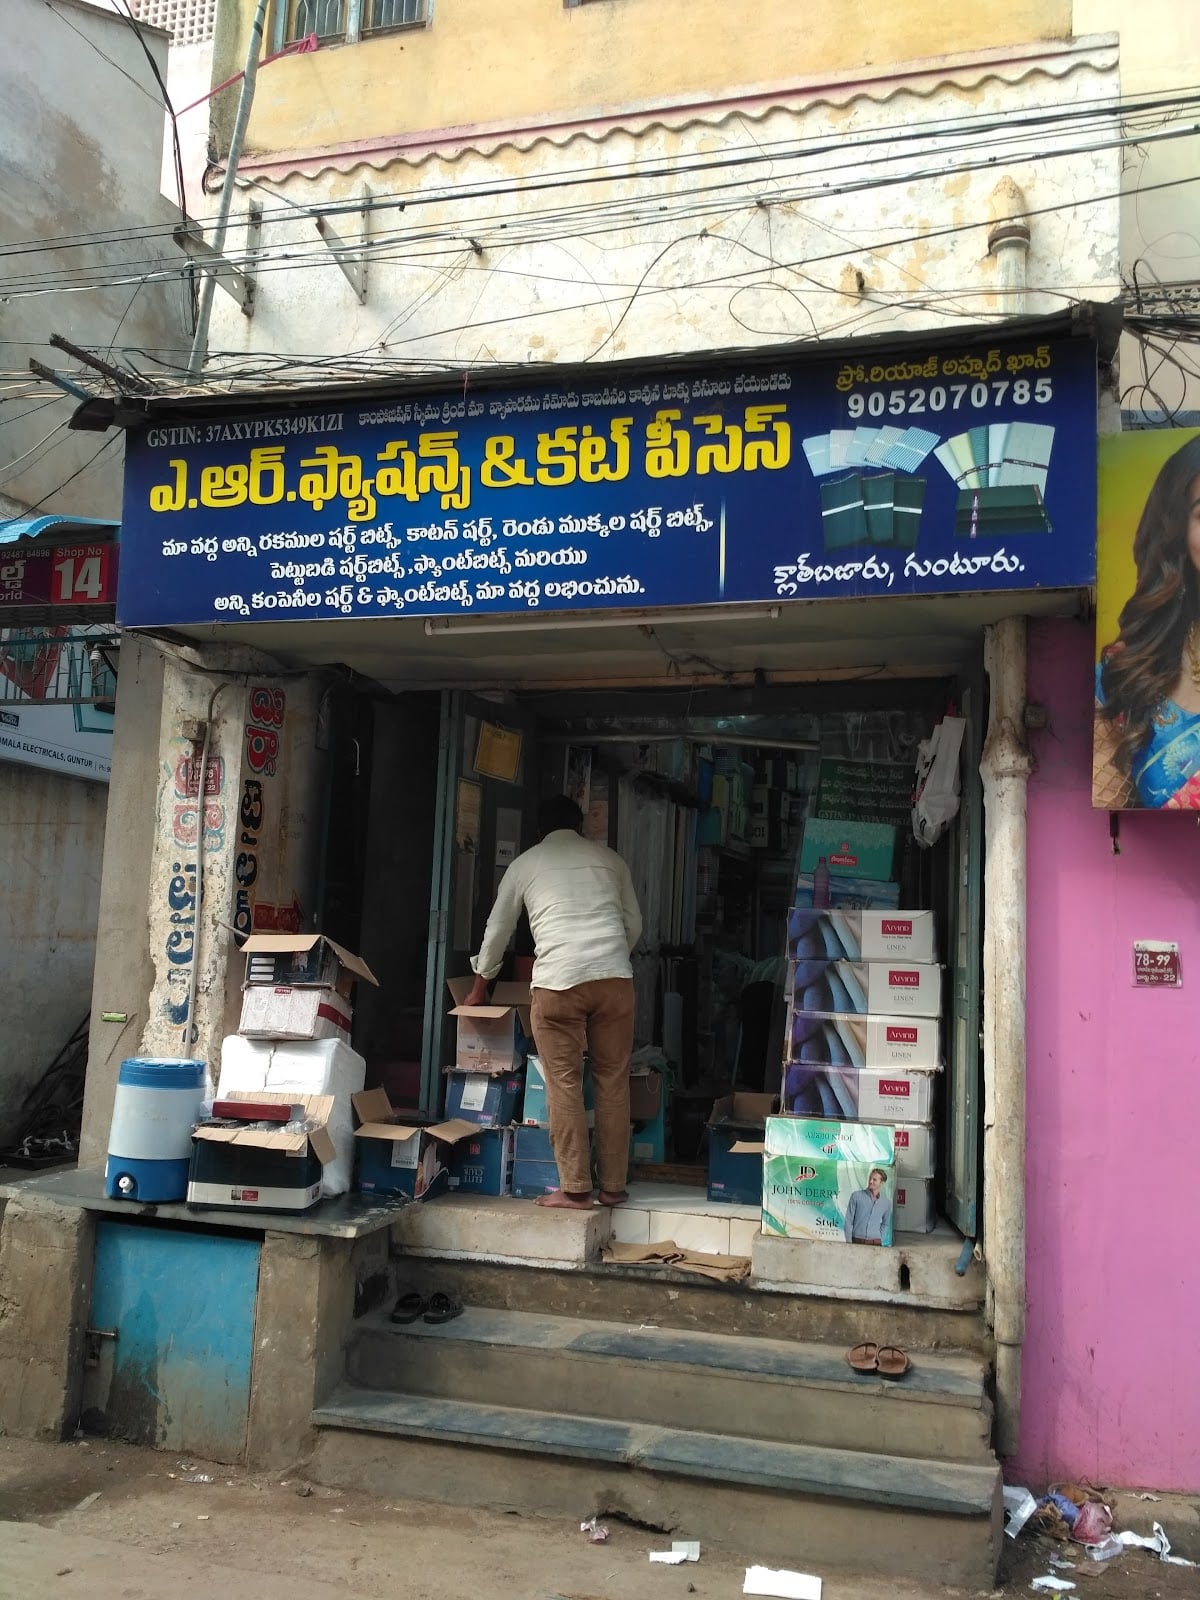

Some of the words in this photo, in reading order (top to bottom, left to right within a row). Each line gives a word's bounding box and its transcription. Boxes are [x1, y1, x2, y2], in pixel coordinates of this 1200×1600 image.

[942, 349, 1002, 381] అహ్మద్
[1006, 345, 1051, 375] ఖాన్
[847, 378, 1053, 418] 9052070785
[147, 425, 202, 447] GSTIN:
[480, 435, 535, 488] &
[536, 416, 634, 486] కట్
[645, 404, 792, 477] పీసెస్
[56, 547, 85, 559] Shop
[87, 546, 105, 556] No.
[162, 538, 188, 556] మా
[190, 535, 219, 562] వద్ద
[221, 536, 258, 557] అన్ని
[259, 531, 326, 550] రకముల
[328, 524, 358, 554] షర్ట్
[406, 518, 459, 542] కాటన్
[462, 517, 498, 547] షర్ట్,
[502, 516, 555, 537] రెండు
[558, 513, 627, 538] ముక్కల
[630, 507, 663, 538] షర్ట్
[54, 556, 103, 600] 14
[270, 556, 336, 586] పెట్టుబడి
[514, 546, 588, 568] మరియు
[903, 547, 1025, 578] గుంటూరు.
[213, 594, 250, 616] అన్ని
[251, 588, 322, 609] కంపెనీల
[325, 584, 355, 614] షర్ట్
[356, 586, 374, 605] &
[476, 582, 505, 601] మా
[508, 578, 541, 607] వద్ద
[544, 574, 646, 599] లభించును.
[22, 742, 67, 762] ELECTRICALS,
[67, 754, 93, 768] GUNTUR
[1135, 953, 1171, 966] 78-99
[771, 1184, 802, 1196] JOHN
[805, 1187, 840, 1199] DERRY
